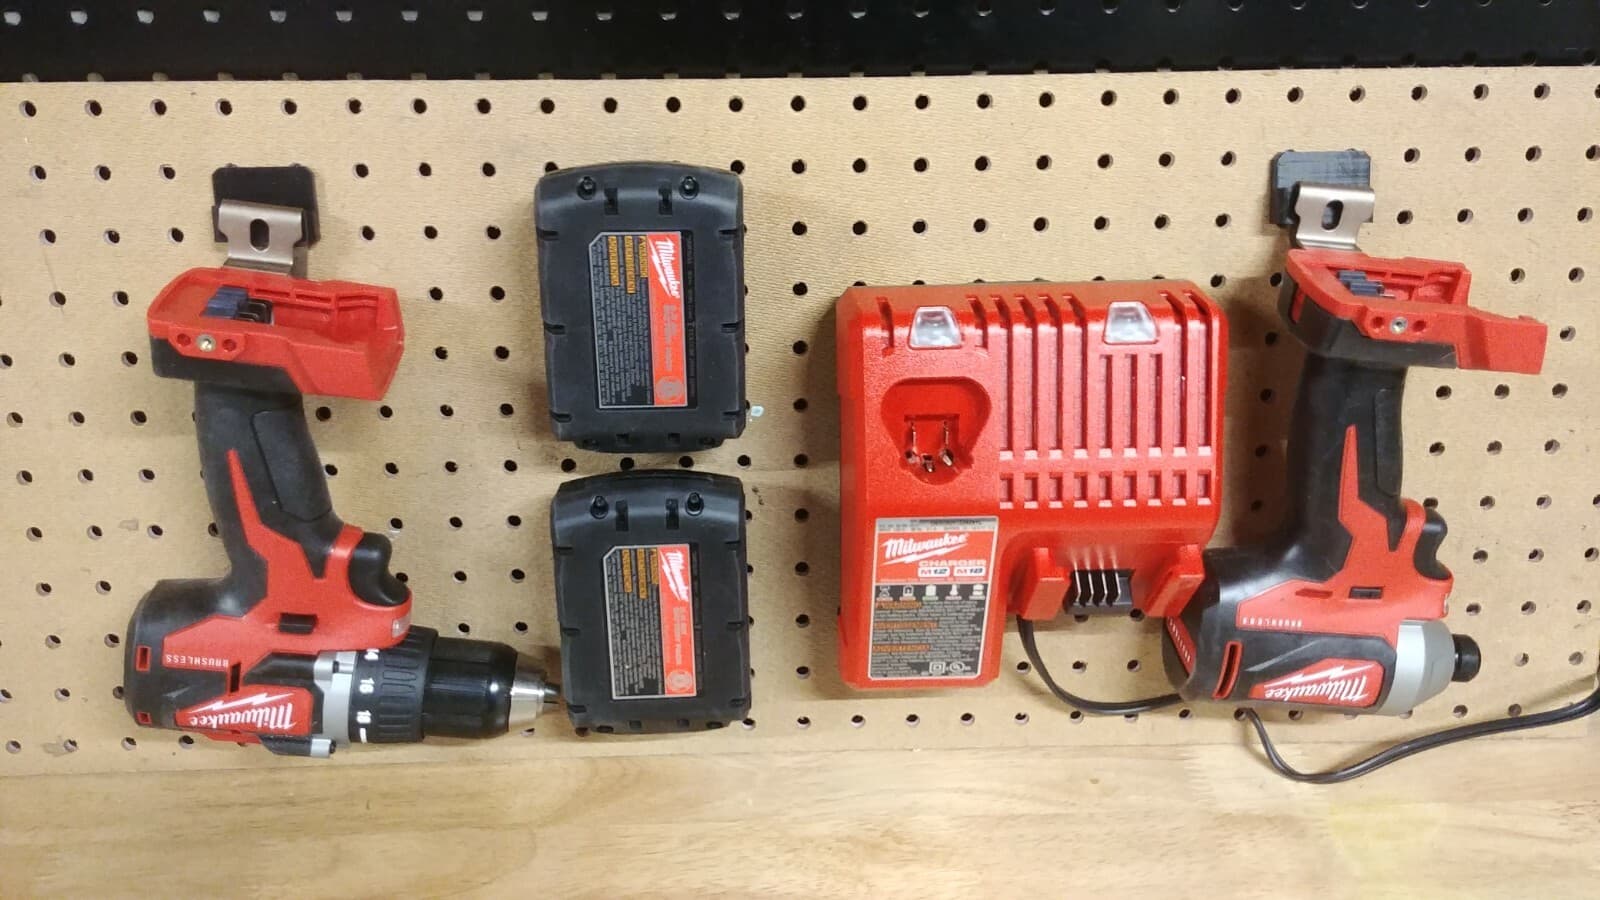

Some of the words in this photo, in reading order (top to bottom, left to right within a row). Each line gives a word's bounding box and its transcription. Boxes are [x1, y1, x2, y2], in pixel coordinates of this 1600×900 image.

[655, 236, 681, 298] Milwaukee
[880, 533, 968, 559] Milwaukee
[918, 559, 987, 567] CHARGER
[920, 567, 949, 576] M12
[165, 654, 229, 668] BRUSHLESS
[359, 677, 375, 694] 16
[1264, 676, 1369, 702] Milwaukee
[190, 702, 297, 730] Milwaukee
